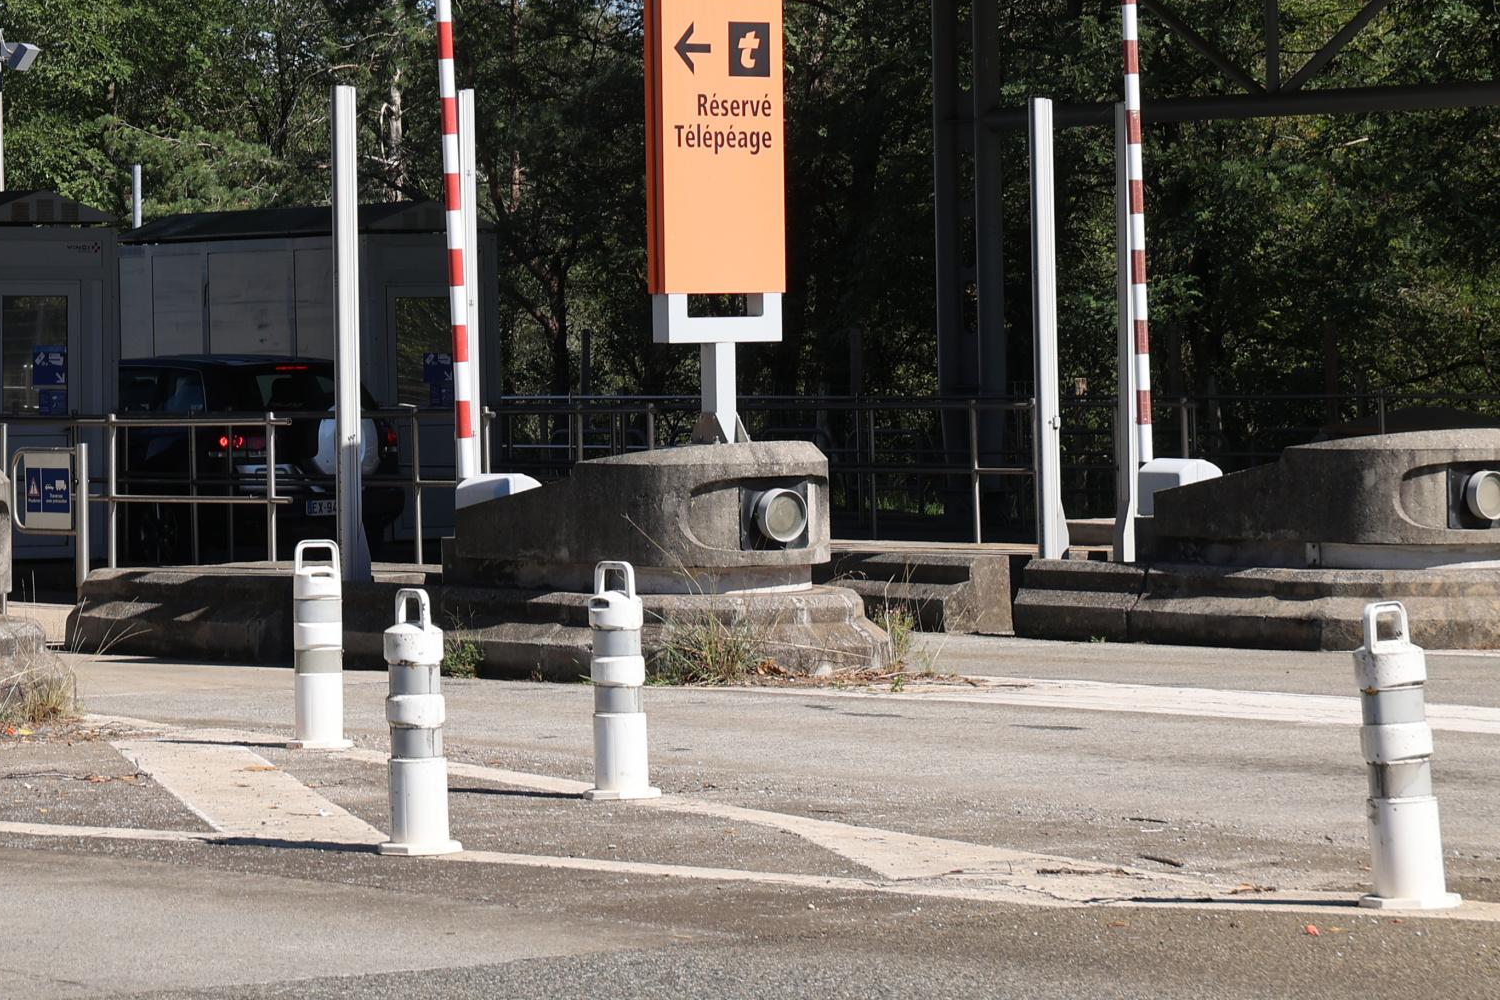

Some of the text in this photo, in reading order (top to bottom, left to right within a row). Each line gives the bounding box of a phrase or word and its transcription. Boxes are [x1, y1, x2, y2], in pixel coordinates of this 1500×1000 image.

[738, 30, 760, 69] t
[697, 92, 772, 117] Réservé
[674, 123, 772, 155] Télépéage
